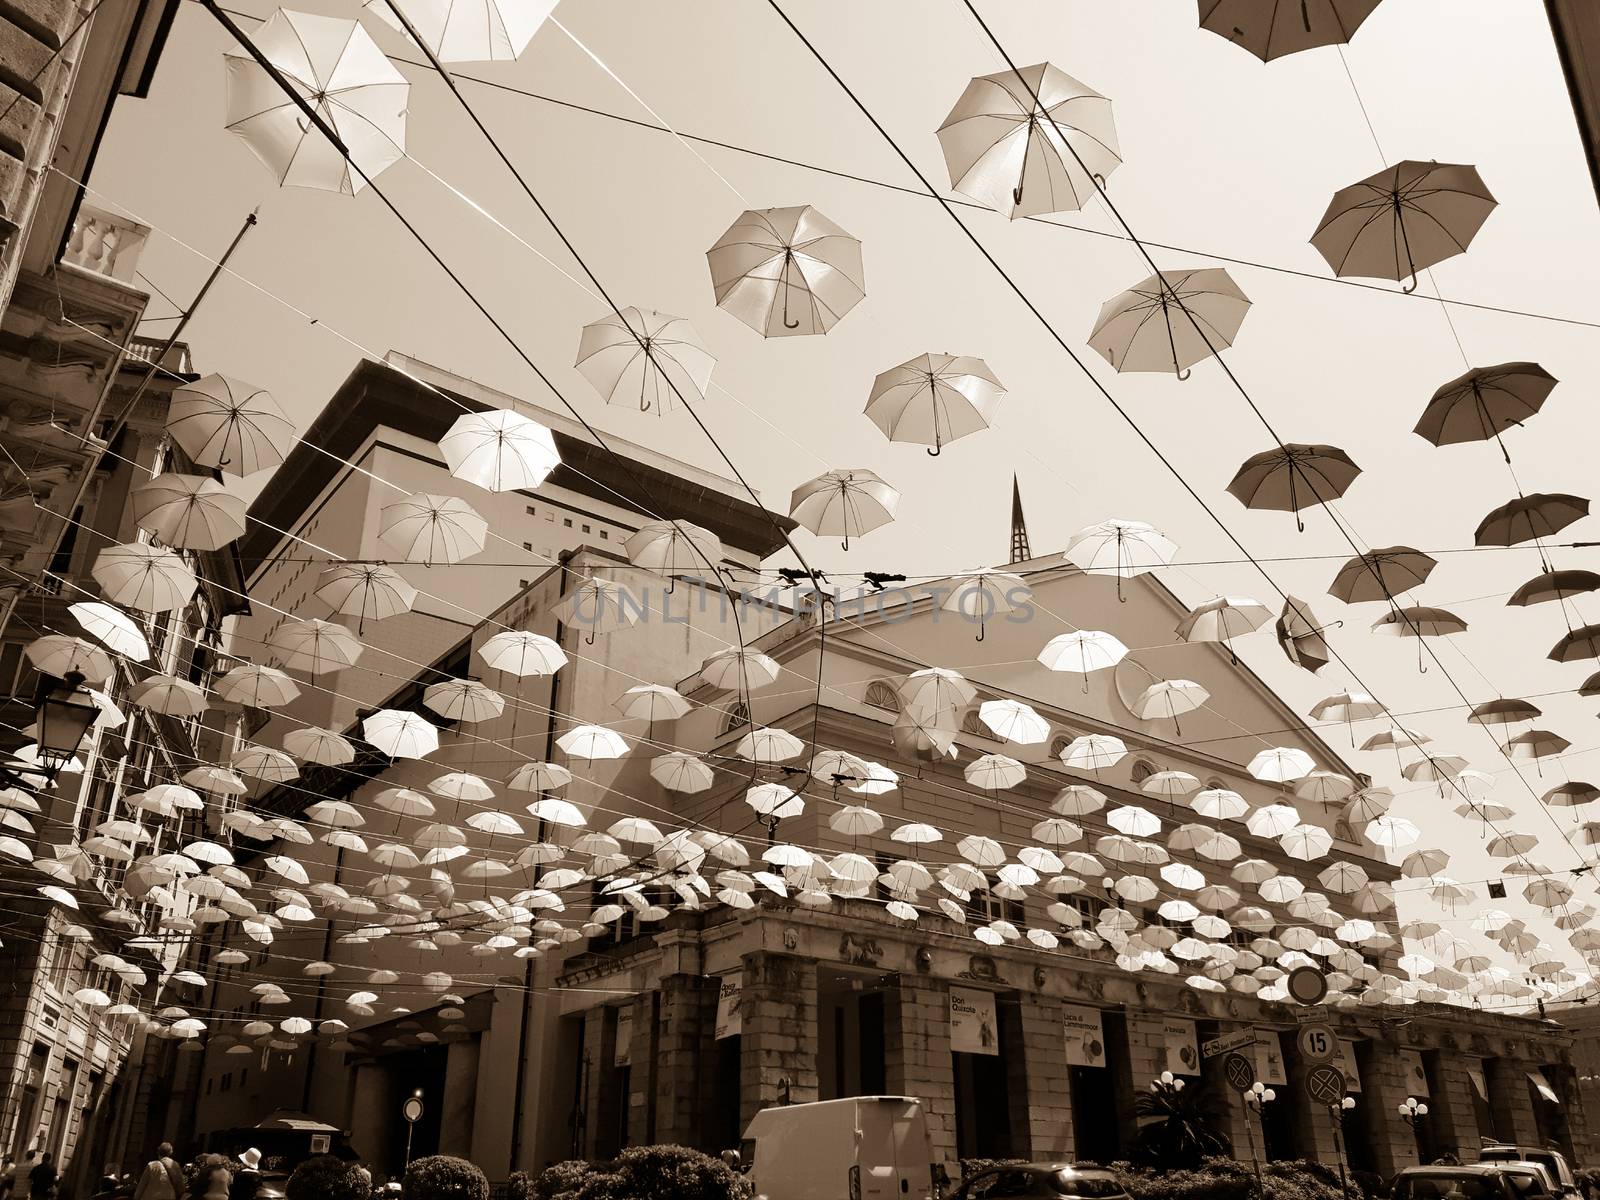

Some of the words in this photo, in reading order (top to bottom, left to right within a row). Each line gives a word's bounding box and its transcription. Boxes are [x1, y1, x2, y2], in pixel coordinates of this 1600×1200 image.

[952, 996, 965, 1004] Don
[952, 1004, 976, 1014] Quixote
[1309, 1032, 1327, 1053] 15
